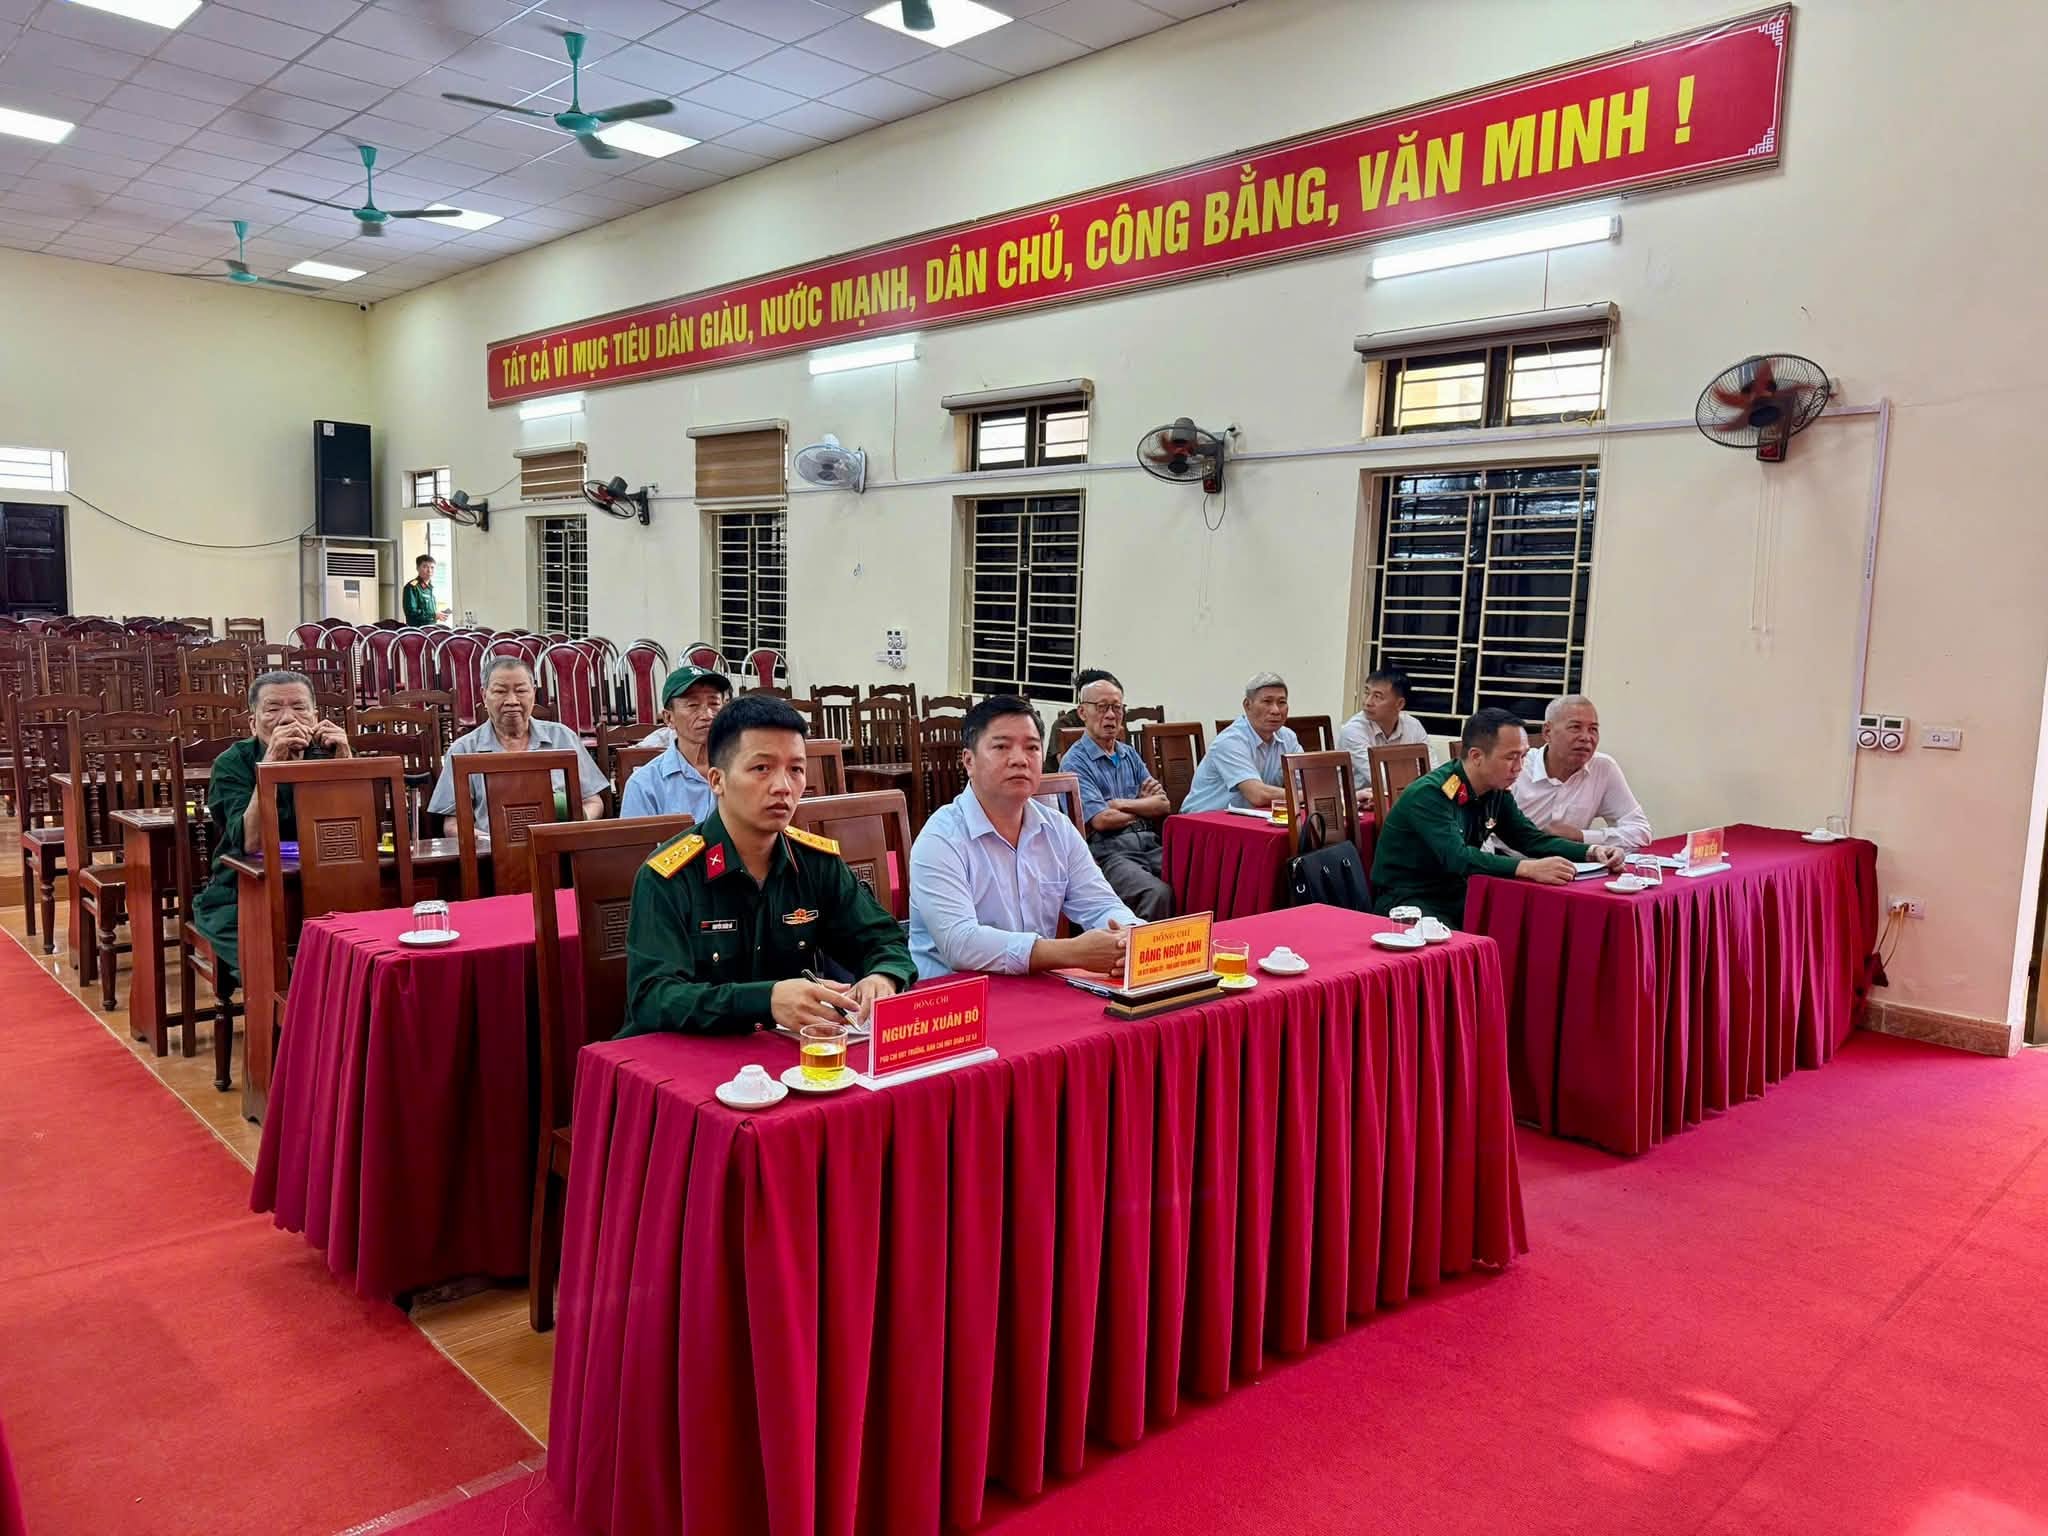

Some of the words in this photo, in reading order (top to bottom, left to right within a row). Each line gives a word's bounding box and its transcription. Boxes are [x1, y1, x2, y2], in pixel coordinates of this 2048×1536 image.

[502, 344, 528, 389] TẤT
[530, 335, 551, 384] CẢ
[553, 335, 568, 378] VÌ
[572, 335, 609, 380] MỤC
[612, 321, 651, 366] TIÊU
[655, 311, 694, 358] DÂN
[700, 300, 754, 351] GIÀU,
[760, 283, 823, 336] NƯỚC
[830, 266, 917, 328] MẠNH,
[926, 244, 987, 304] DÂN
[997, 214, 1073, 290] CHỦ,
[1085, 200, 1190, 271] CÔNG
[1203, 162, 1339, 247] BẰNG,
[1359, 130, 1464, 212] VĂN
[1482, 85, 1650, 186] MINH
[1674, 75, 1696, 145] !
[1163, 943, 1184, 960] NGỌC
[1186, 939, 1202, 954] ANH
[882, 1017, 929, 1043] NGUYỄN
[932, 1011, 962, 1033] XUÂN
